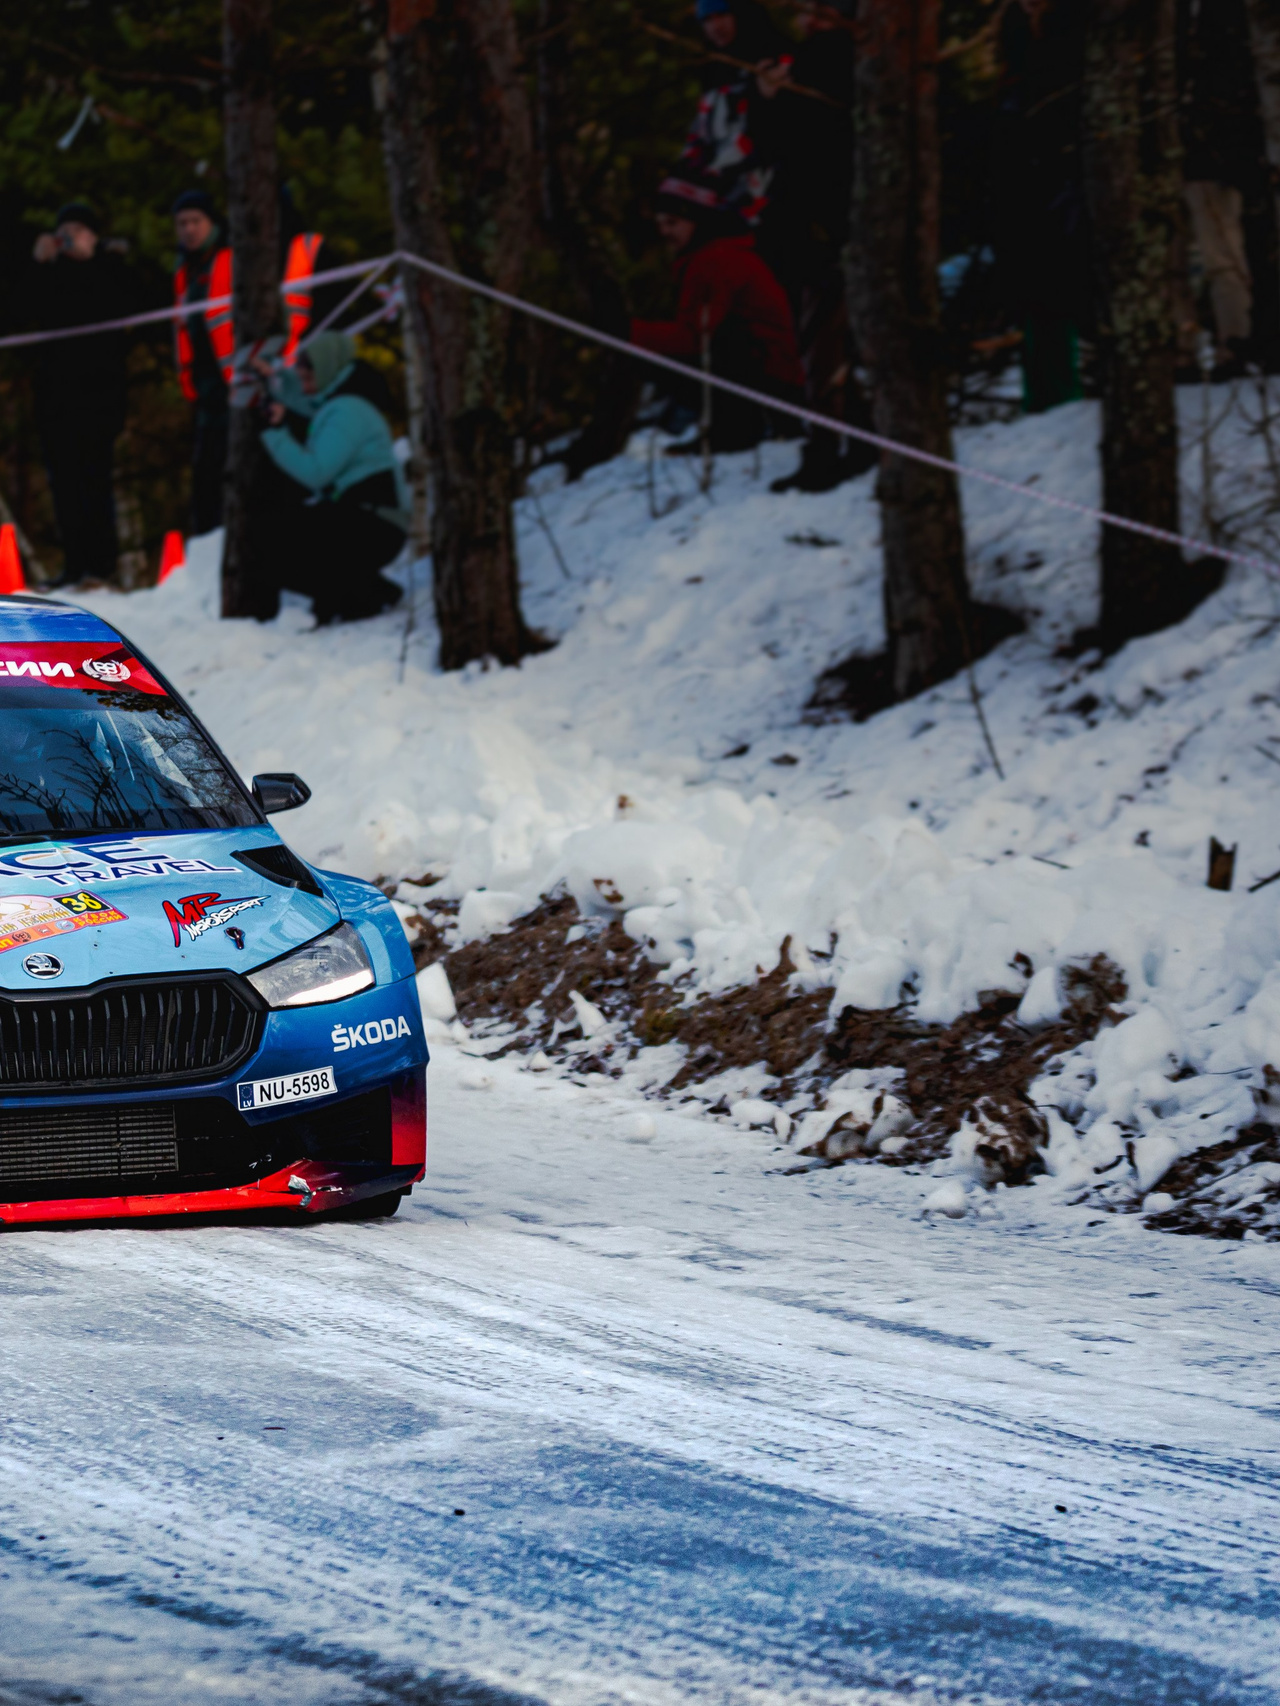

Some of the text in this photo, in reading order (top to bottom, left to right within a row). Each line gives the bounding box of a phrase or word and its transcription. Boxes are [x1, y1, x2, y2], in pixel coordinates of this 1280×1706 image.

[31, 859, 241, 886] TRAVEL
[61, 892, 102, 911] 36
[331, 1015, 411, 1052] ŠKODA
[260, 1072, 330, 1102] NU-5598
[243, 1100, 252, 1108] LV
